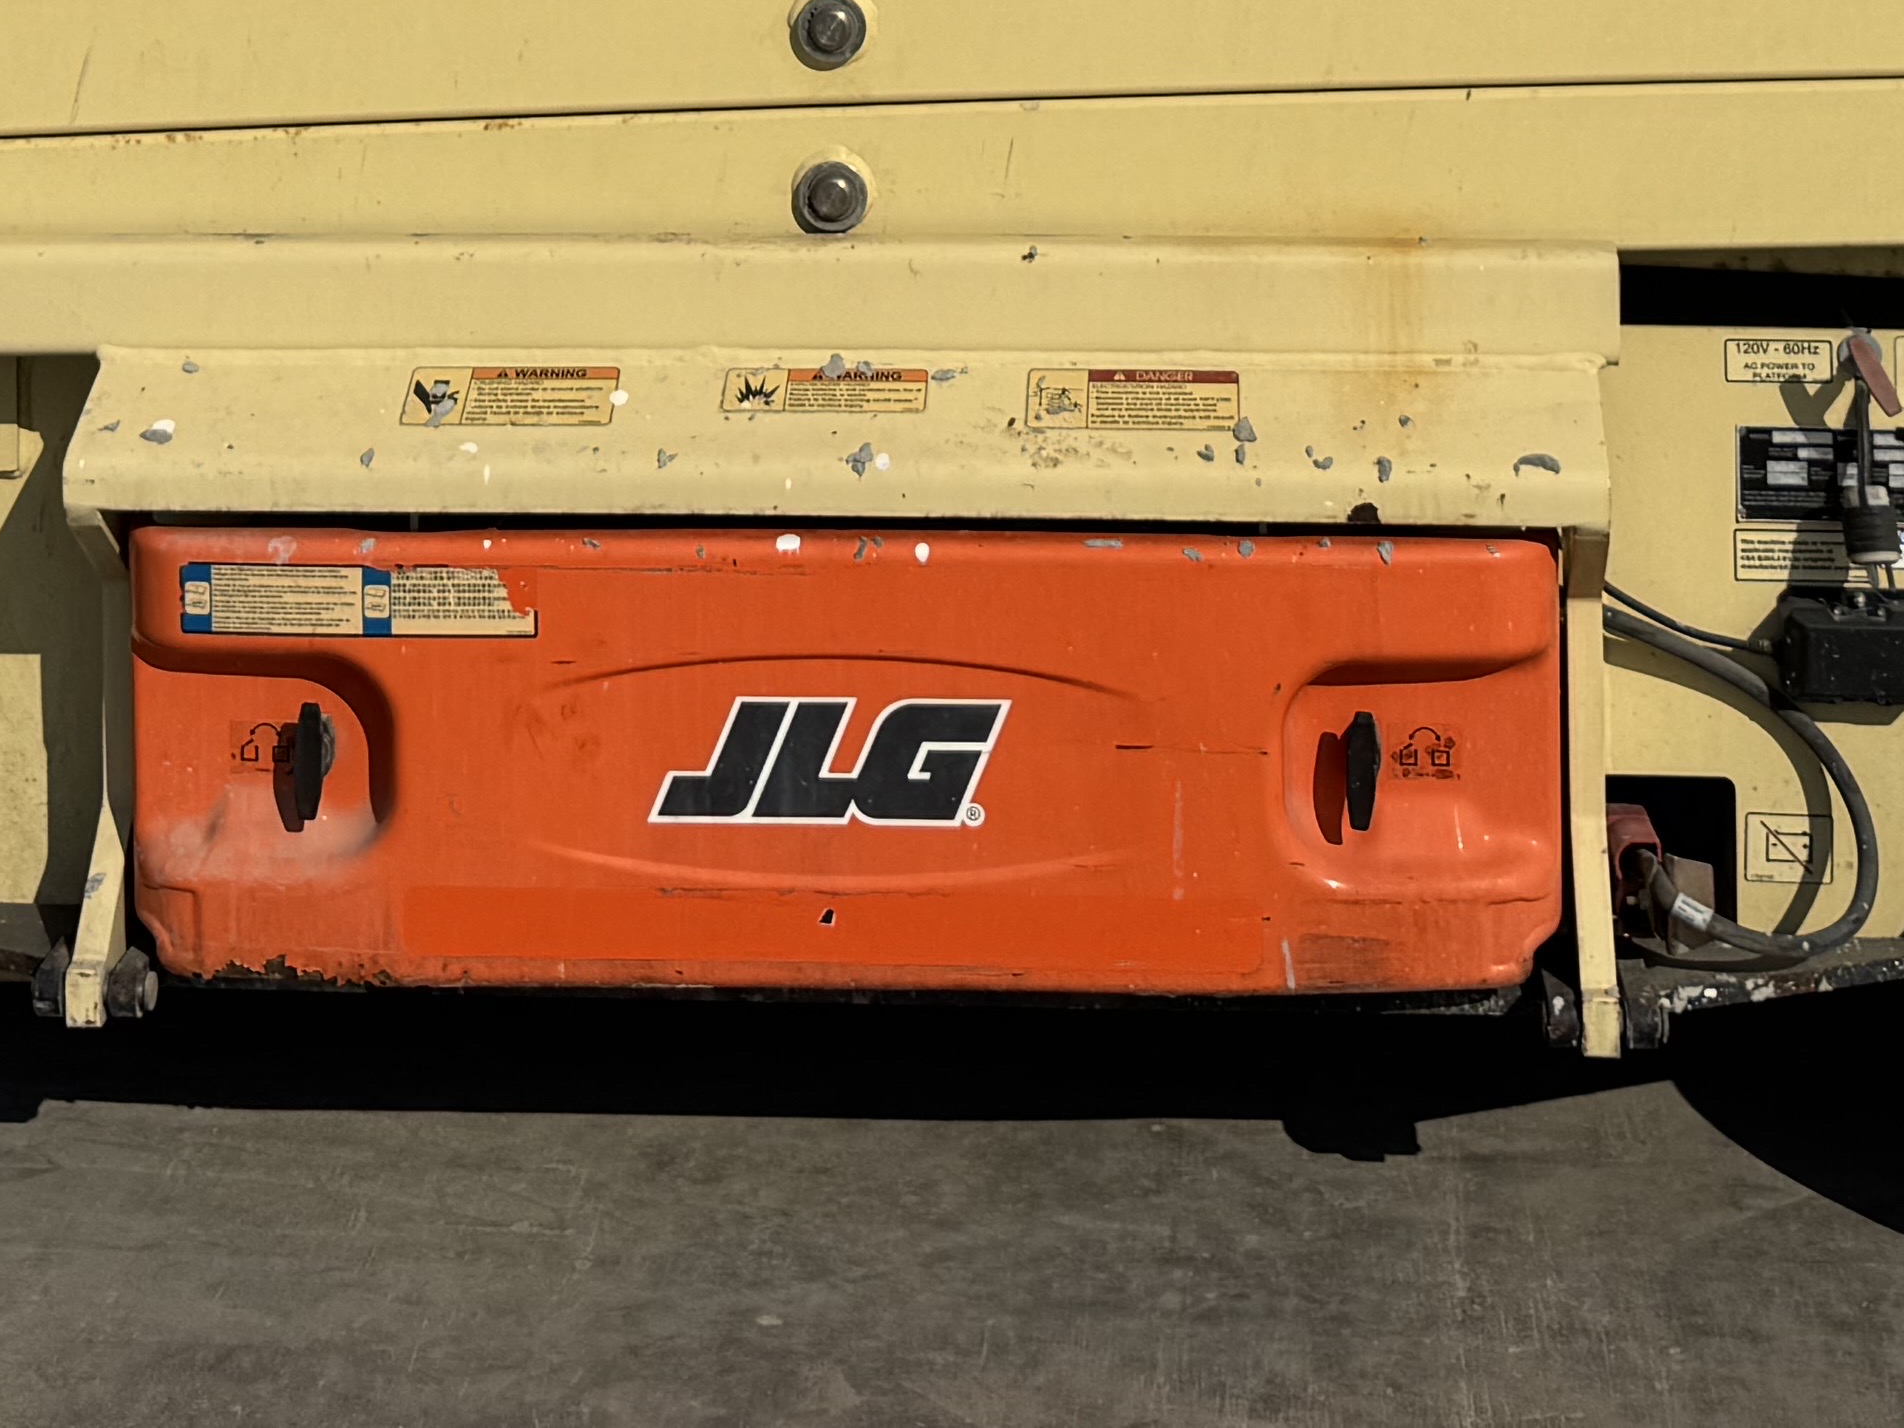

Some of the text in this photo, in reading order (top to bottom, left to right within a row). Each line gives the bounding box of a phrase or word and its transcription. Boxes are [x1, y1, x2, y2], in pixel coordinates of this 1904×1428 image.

[1734, 342, 1770, 355] 120V
[1782, 342, 1820, 355] 60Hz
[1743, 361, 1815, 371] AC POWER TO
[513, 368, 588, 379] WARNING
[1135, 370, 1194, 382] DANGER
[647, 695, 1013, 827] JLG
